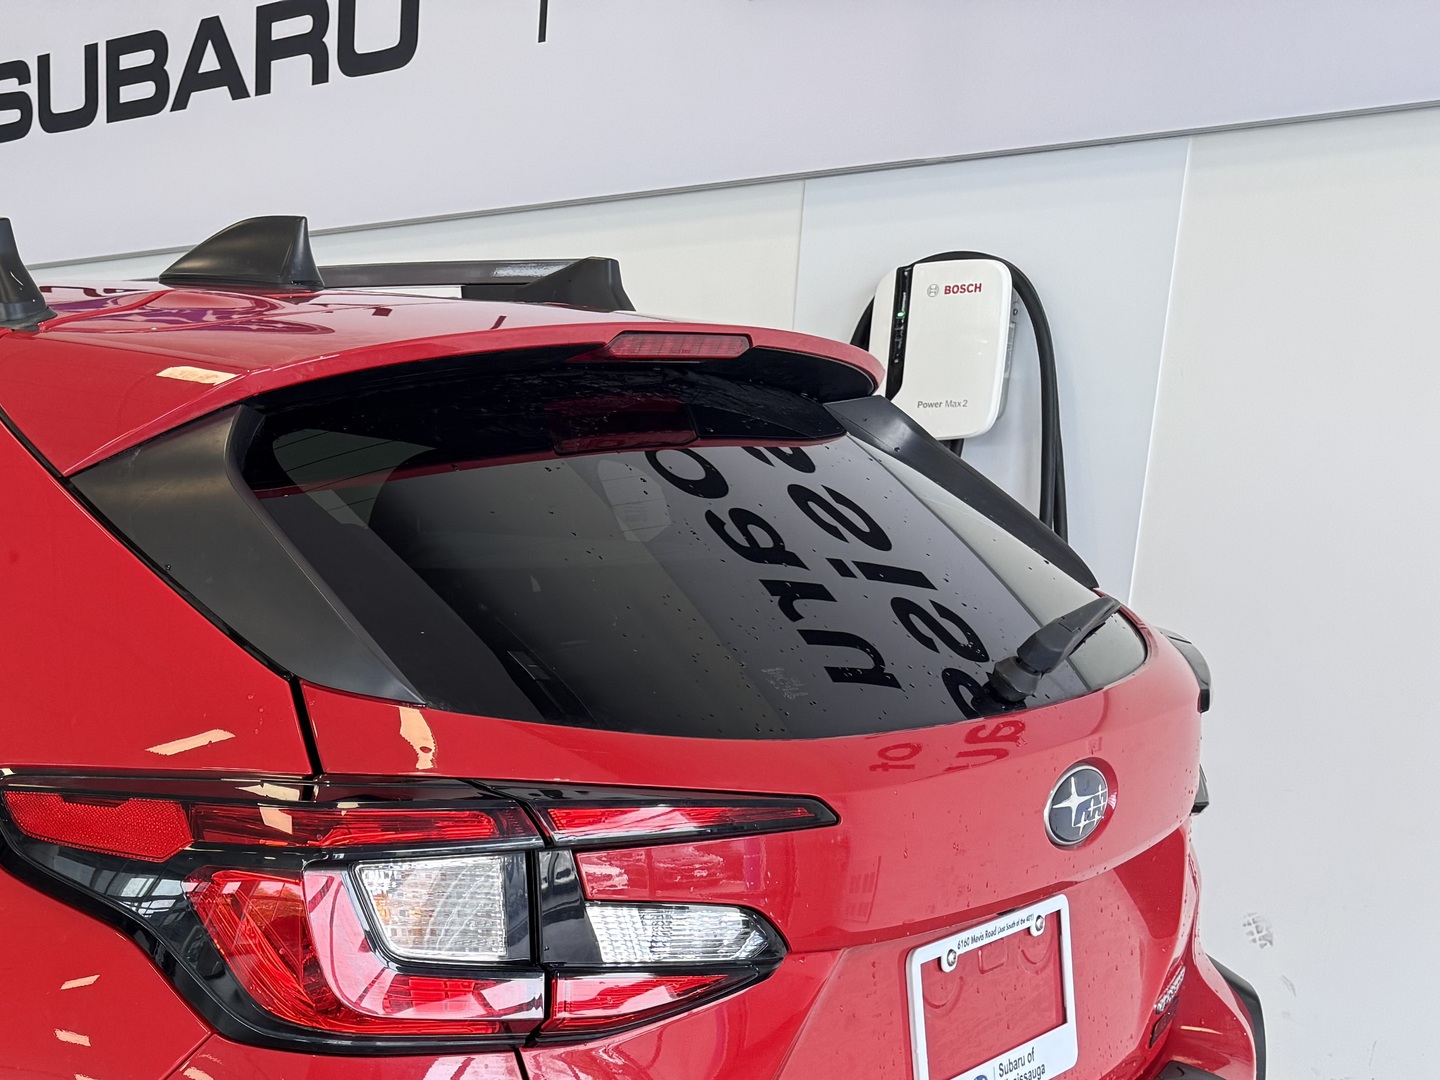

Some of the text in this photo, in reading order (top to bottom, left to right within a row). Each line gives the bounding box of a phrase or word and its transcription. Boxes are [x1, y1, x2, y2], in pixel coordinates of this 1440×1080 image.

[944, 283, 982, 295] BOSCH
[917, 401, 943, 409] Power
[957, 937, 970, 950] 6160
[985, 926, 997, 939] Road
[1006, 921, 1016, 930] South
[998, 1046, 1035, 1078] Subaru of
